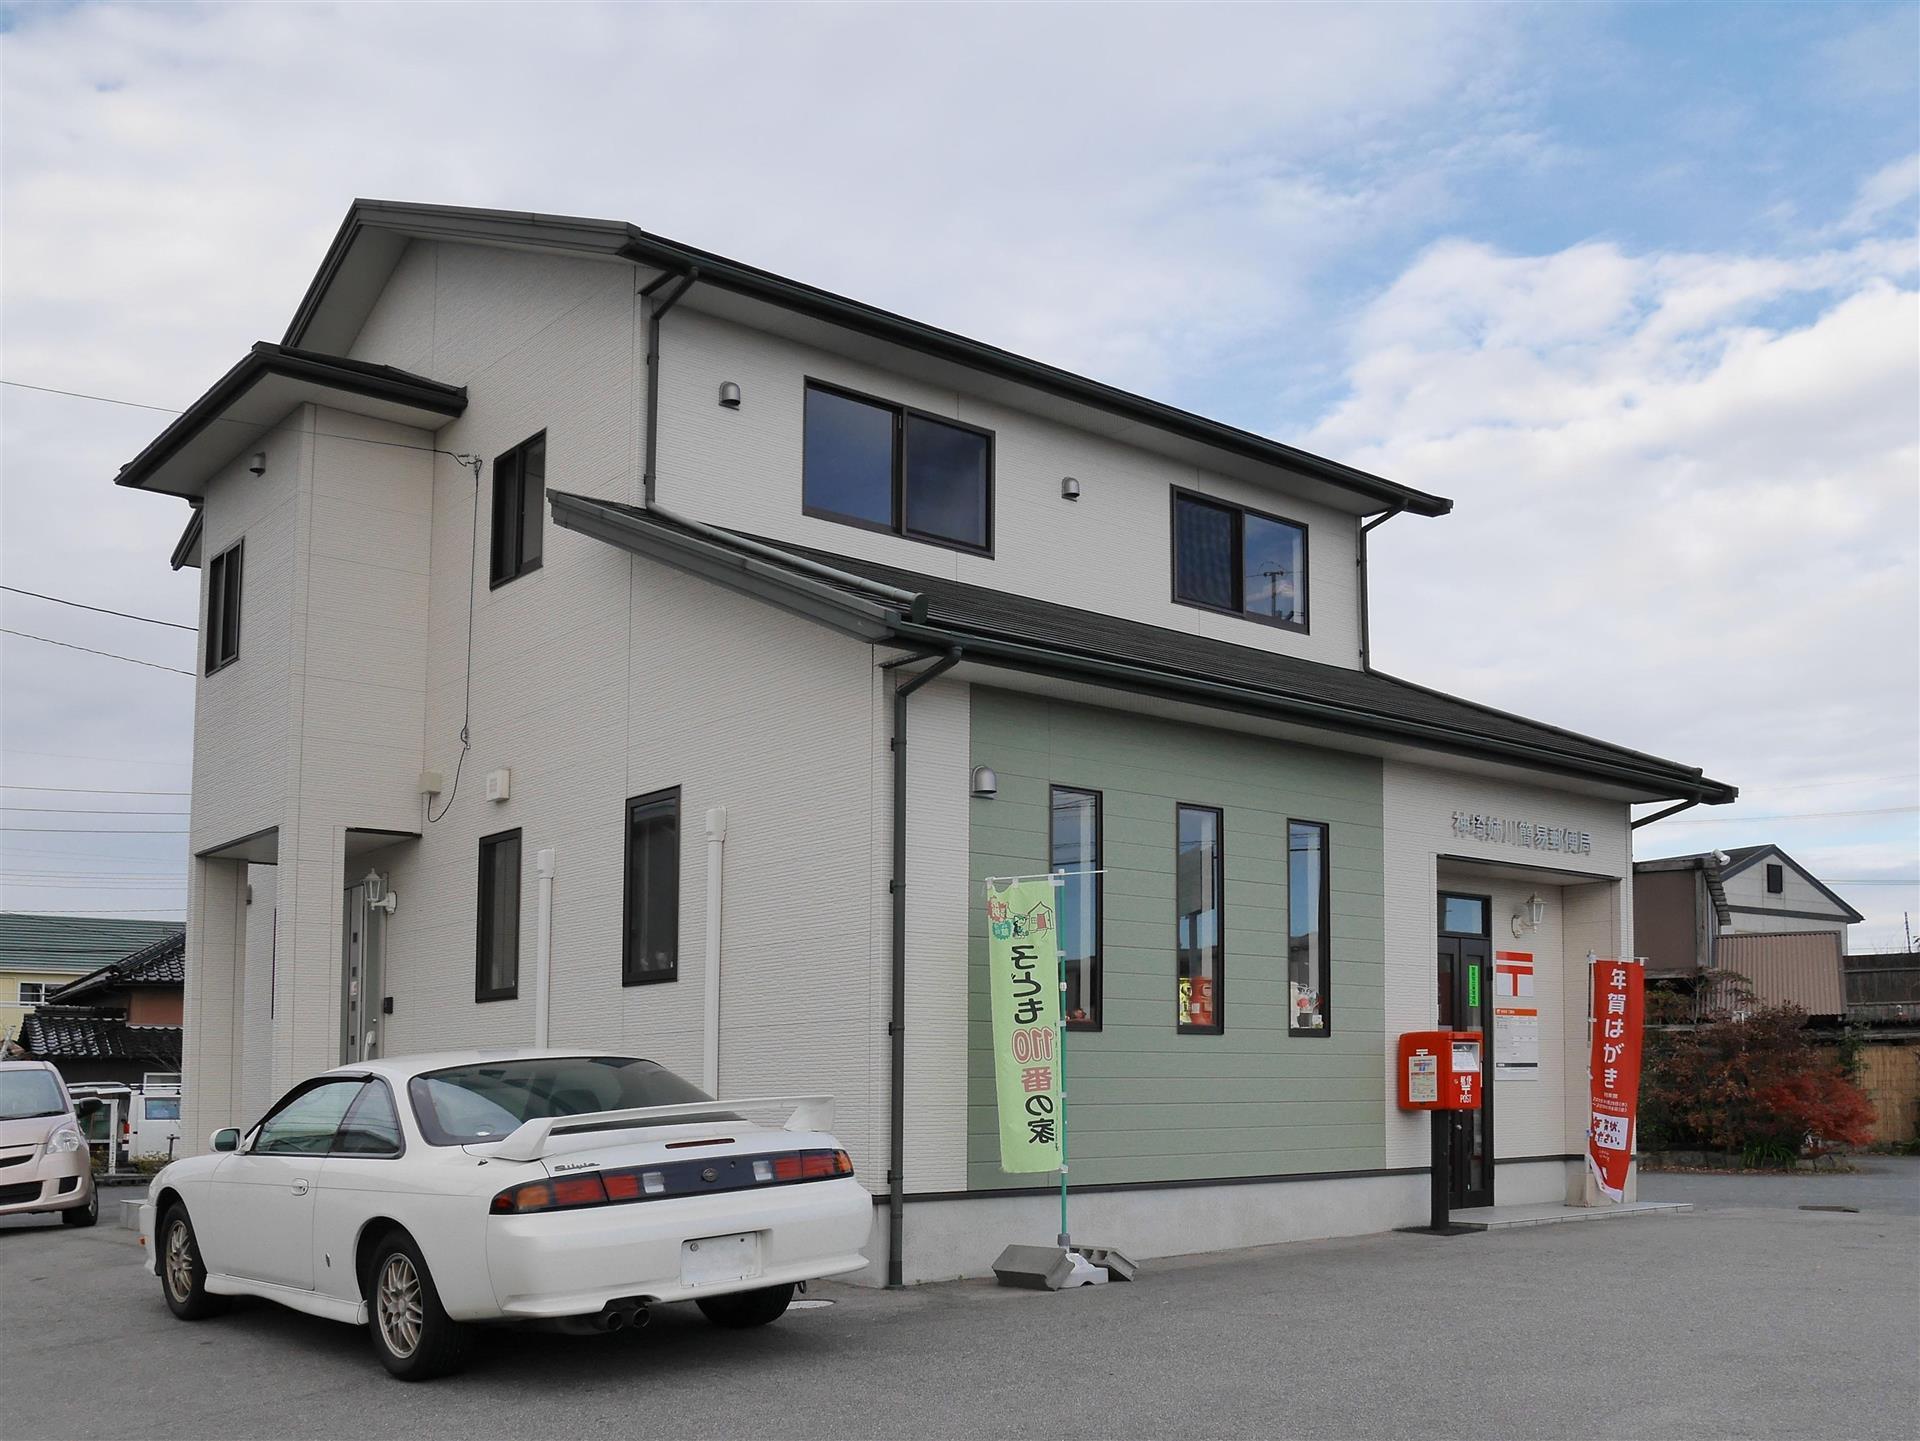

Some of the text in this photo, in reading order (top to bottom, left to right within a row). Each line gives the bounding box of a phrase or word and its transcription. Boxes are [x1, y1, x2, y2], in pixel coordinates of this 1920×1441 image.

[1603, 968, 1627, 1088] 年賀はがき
